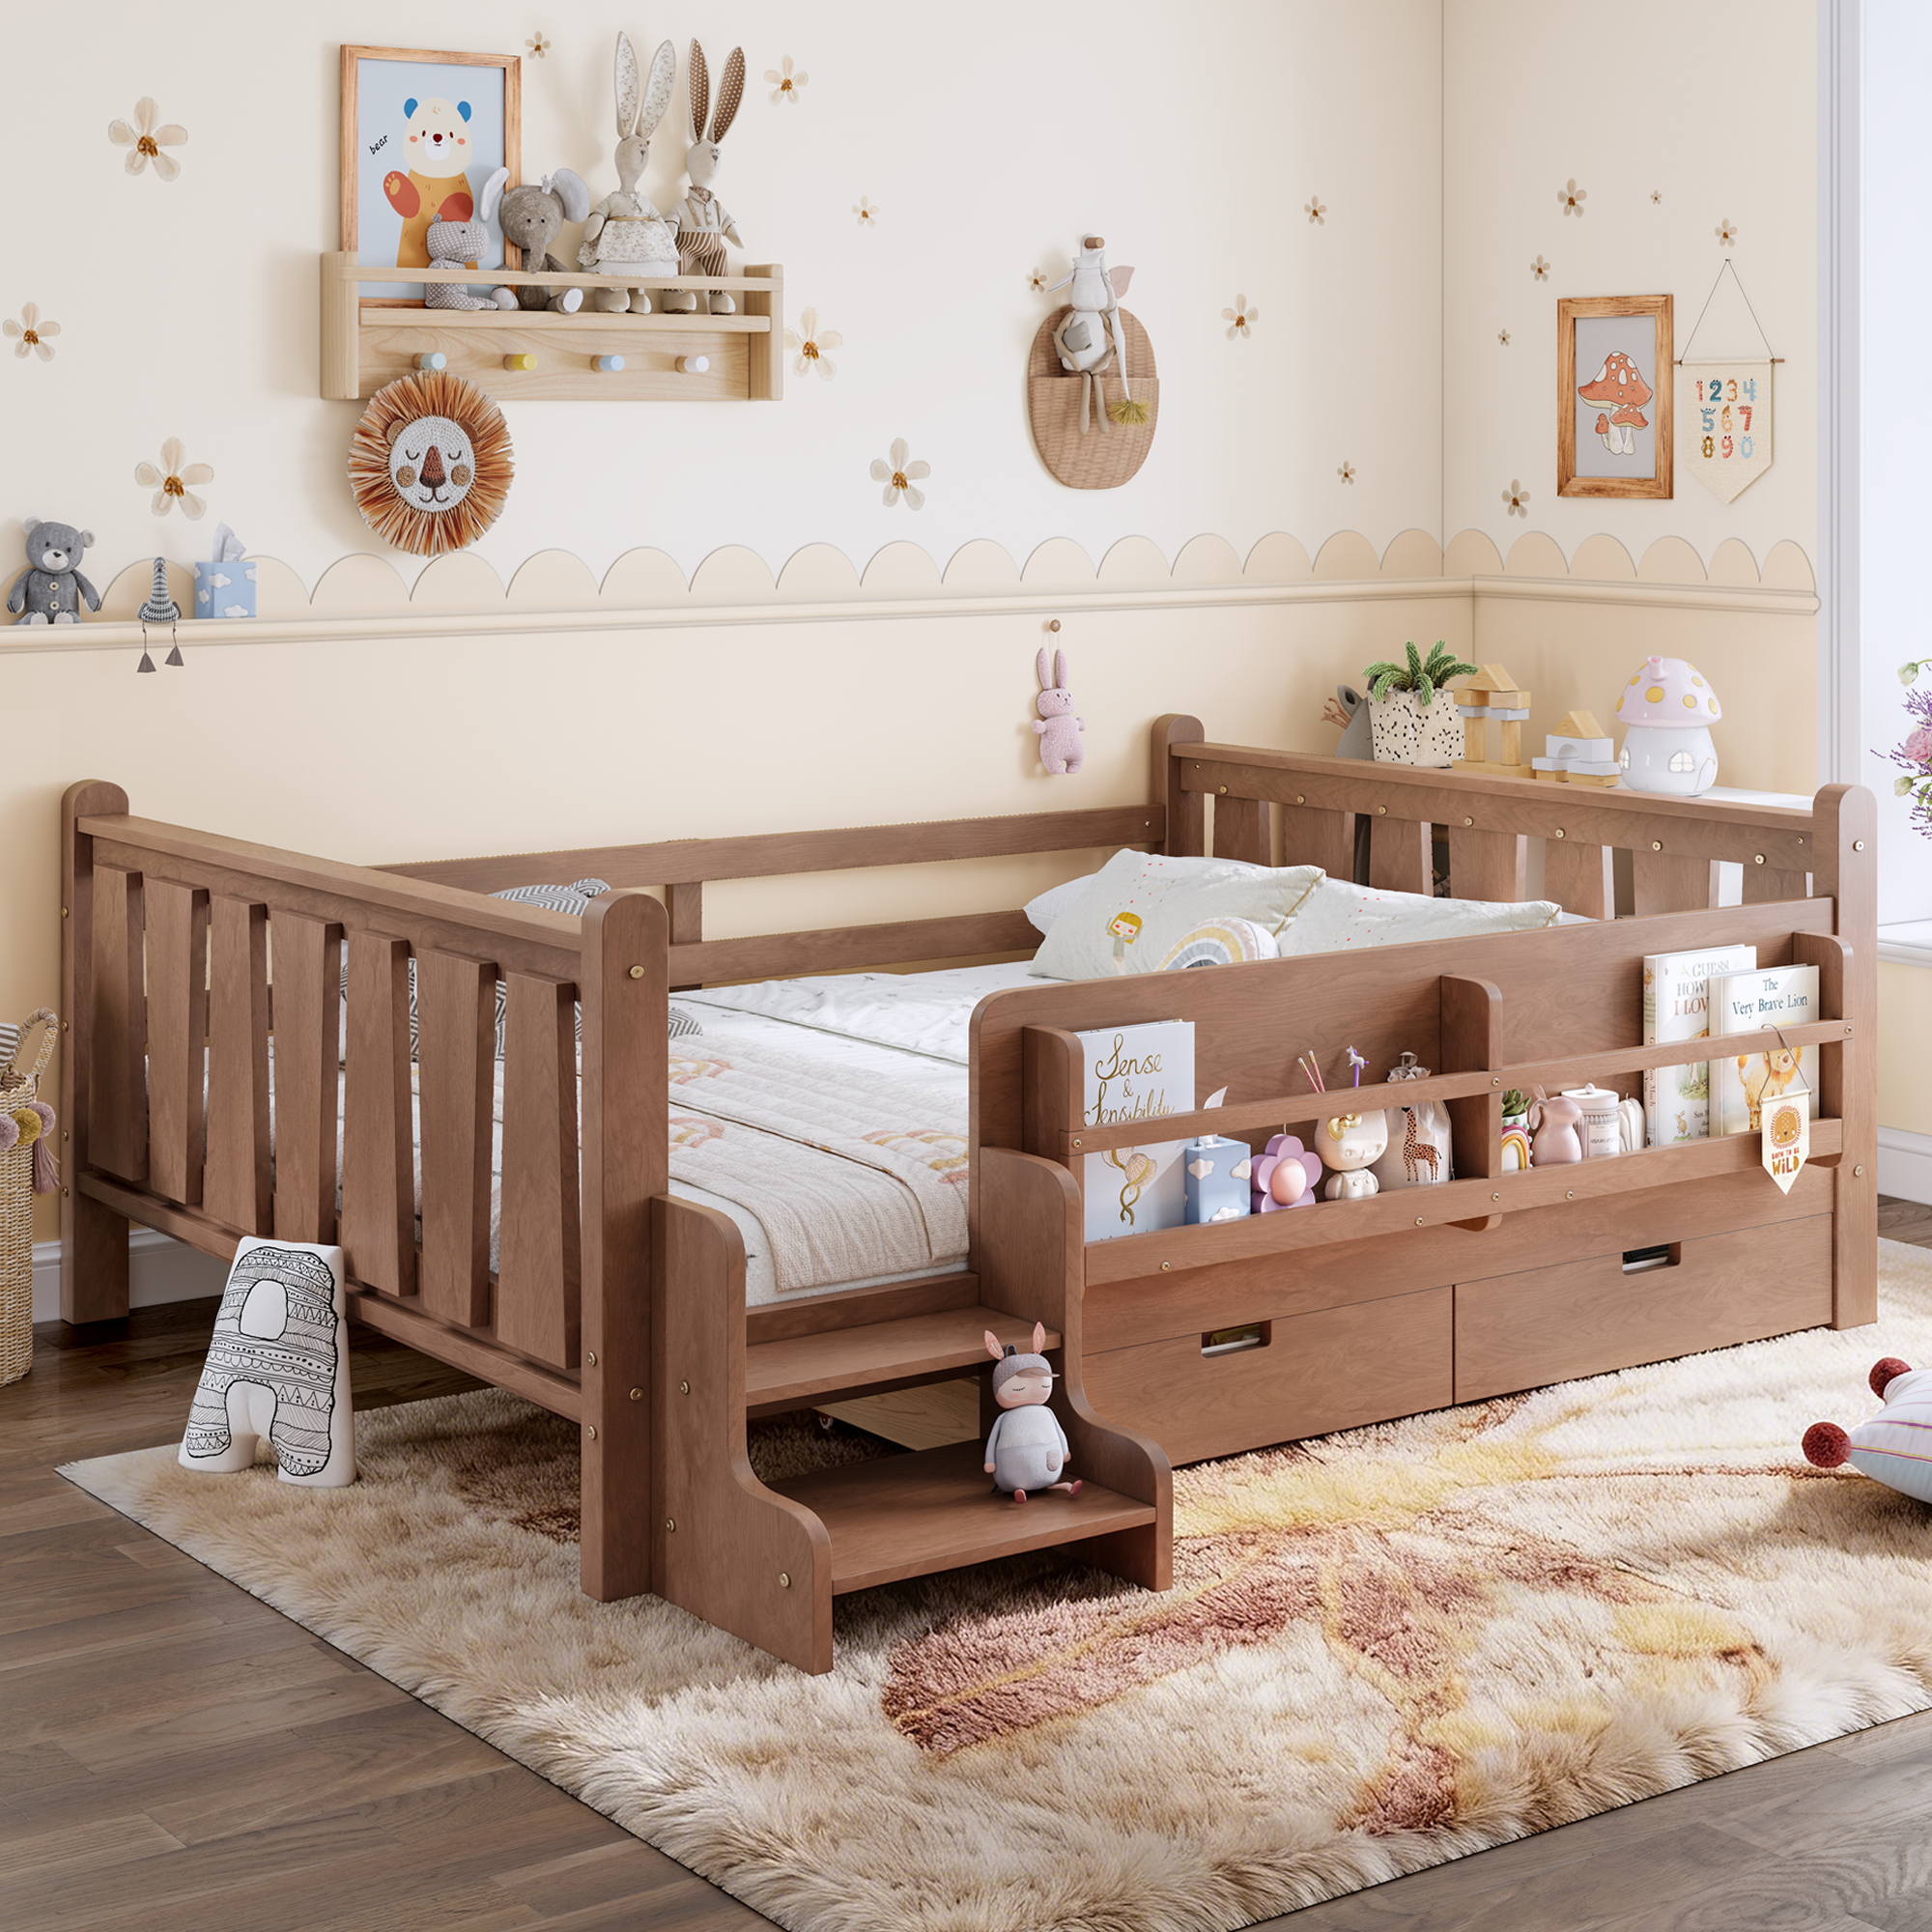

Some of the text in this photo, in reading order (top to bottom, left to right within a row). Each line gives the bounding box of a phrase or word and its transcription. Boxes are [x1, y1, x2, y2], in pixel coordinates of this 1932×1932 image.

[369, 134, 388, 156] bear
[1691, 959, 1729, 978] GUESS
[1762, 977, 1778, 991] The
[1674, 1000, 1679, 1016] I
[1684, 997, 1708, 1016] LOV
[1732, 993, 1808, 1019] Very Brave Lion
[1095, 1033, 1163, 1081] Sense
[1122, 1078, 1134, 1098] &
